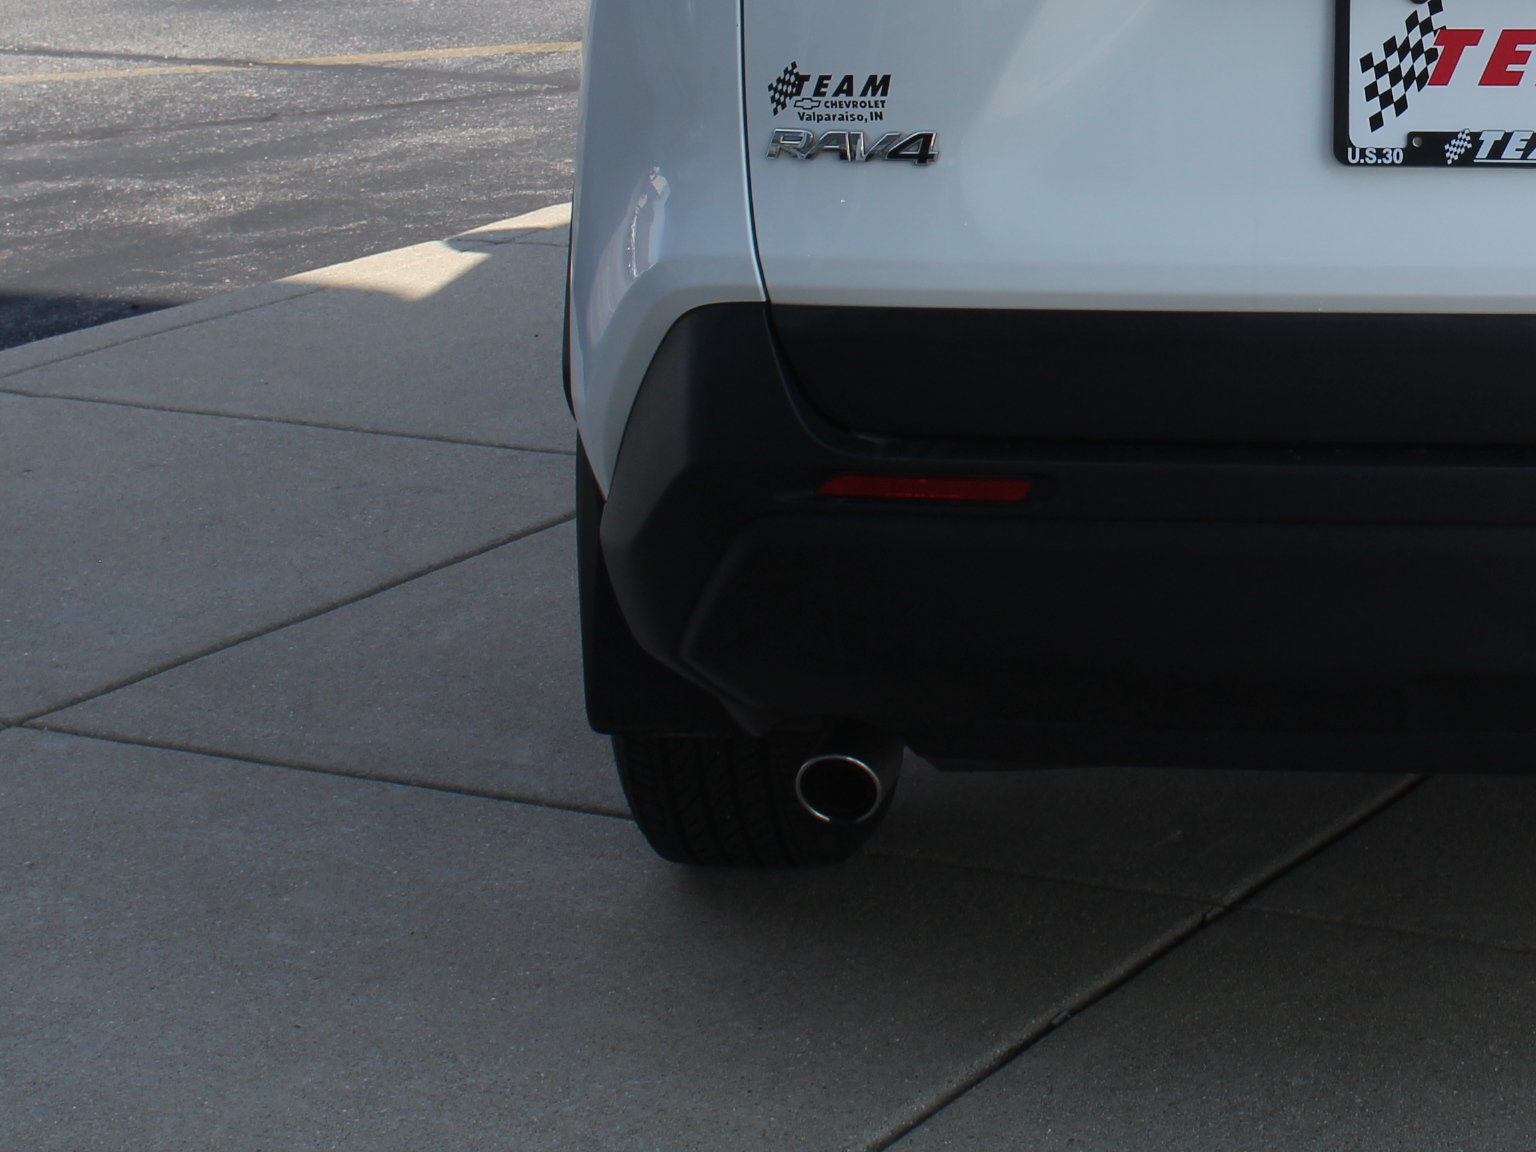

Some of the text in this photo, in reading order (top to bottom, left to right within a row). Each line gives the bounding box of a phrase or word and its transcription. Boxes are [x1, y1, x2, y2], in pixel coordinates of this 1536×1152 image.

[793, 74, 891, 98] TEAM
[824, 100, 886, 109] CHEVROLET
[797, 111, 884, 123] Valparaiso, IN
[766, 128, 939, 166] RAV4
